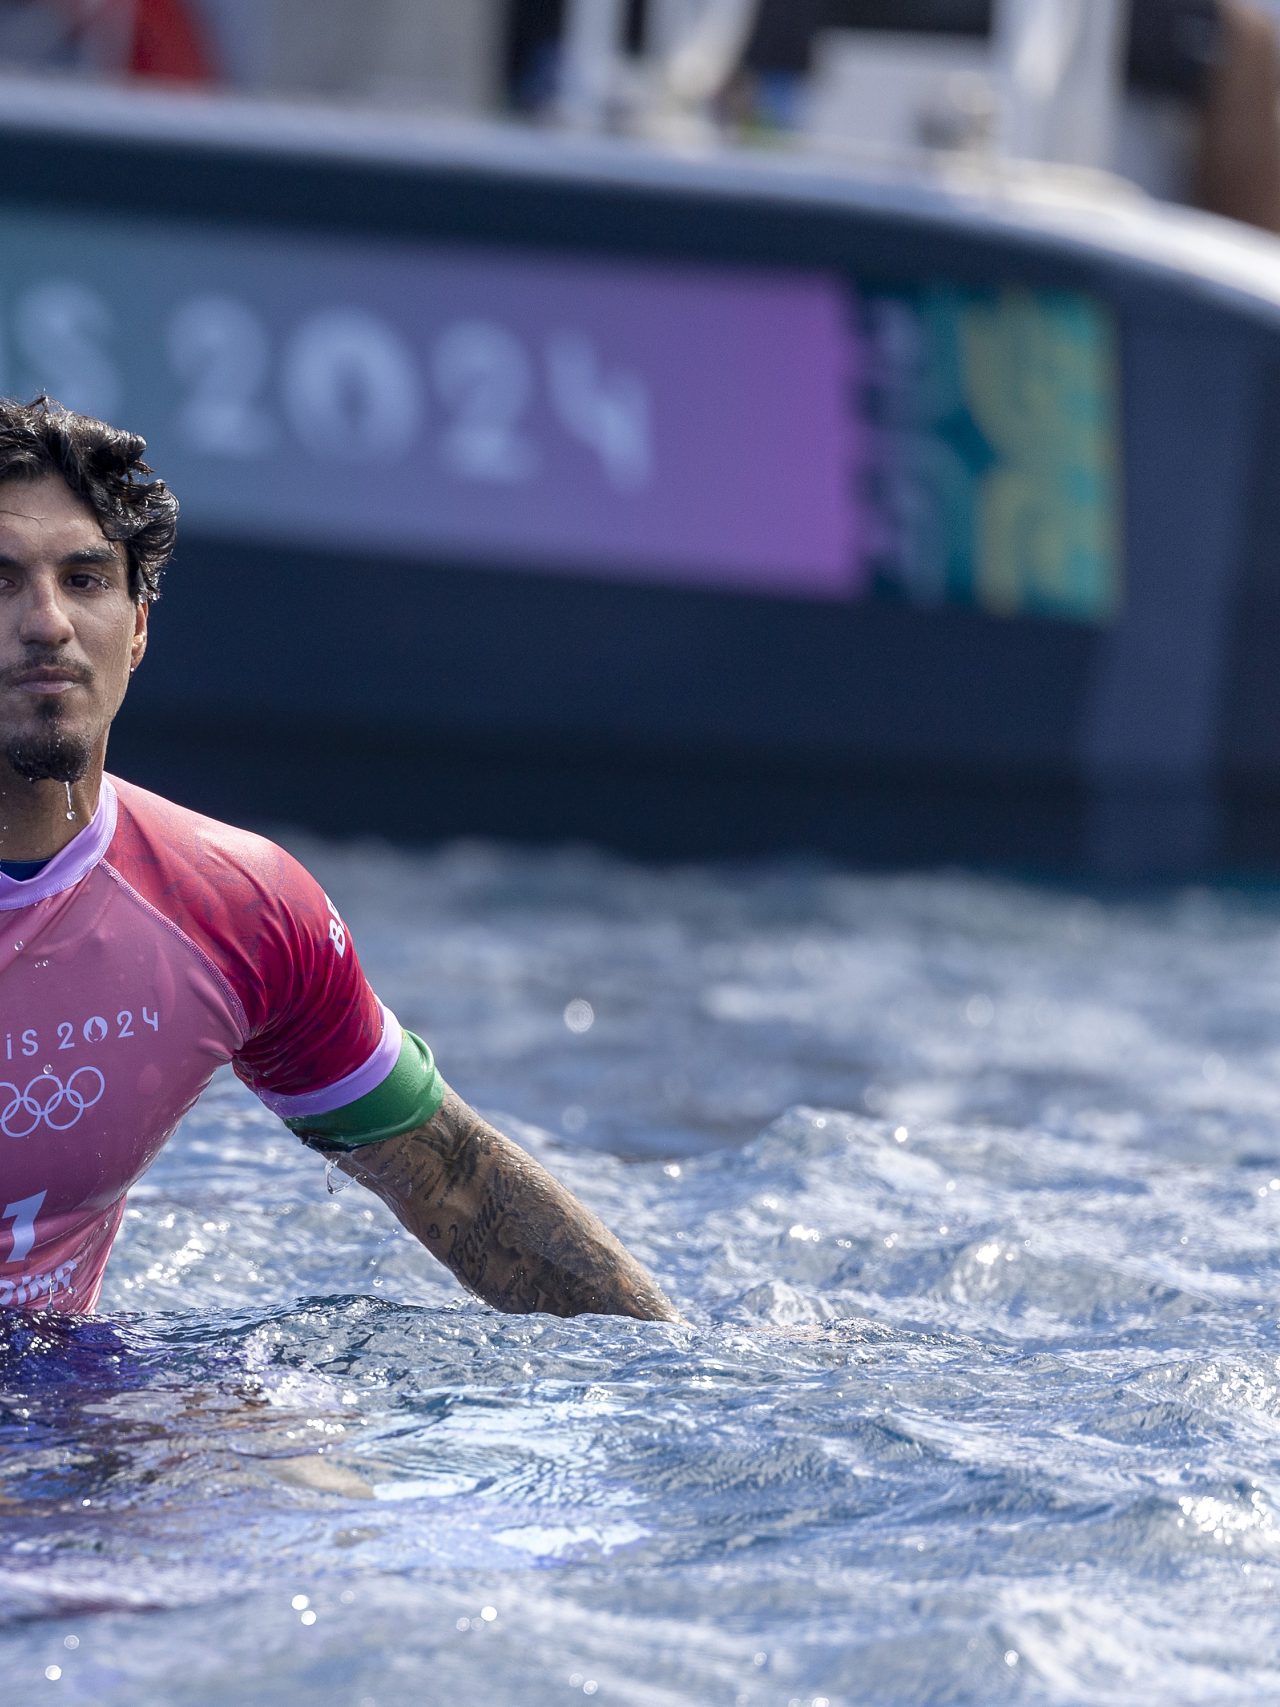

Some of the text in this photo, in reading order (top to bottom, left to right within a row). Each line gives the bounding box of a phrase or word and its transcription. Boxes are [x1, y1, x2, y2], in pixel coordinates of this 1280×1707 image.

[168, 294, 653, 491] 2024
[56, 1006, 160, 1050] 2024
[1, 1189, 48, 1264] 1
